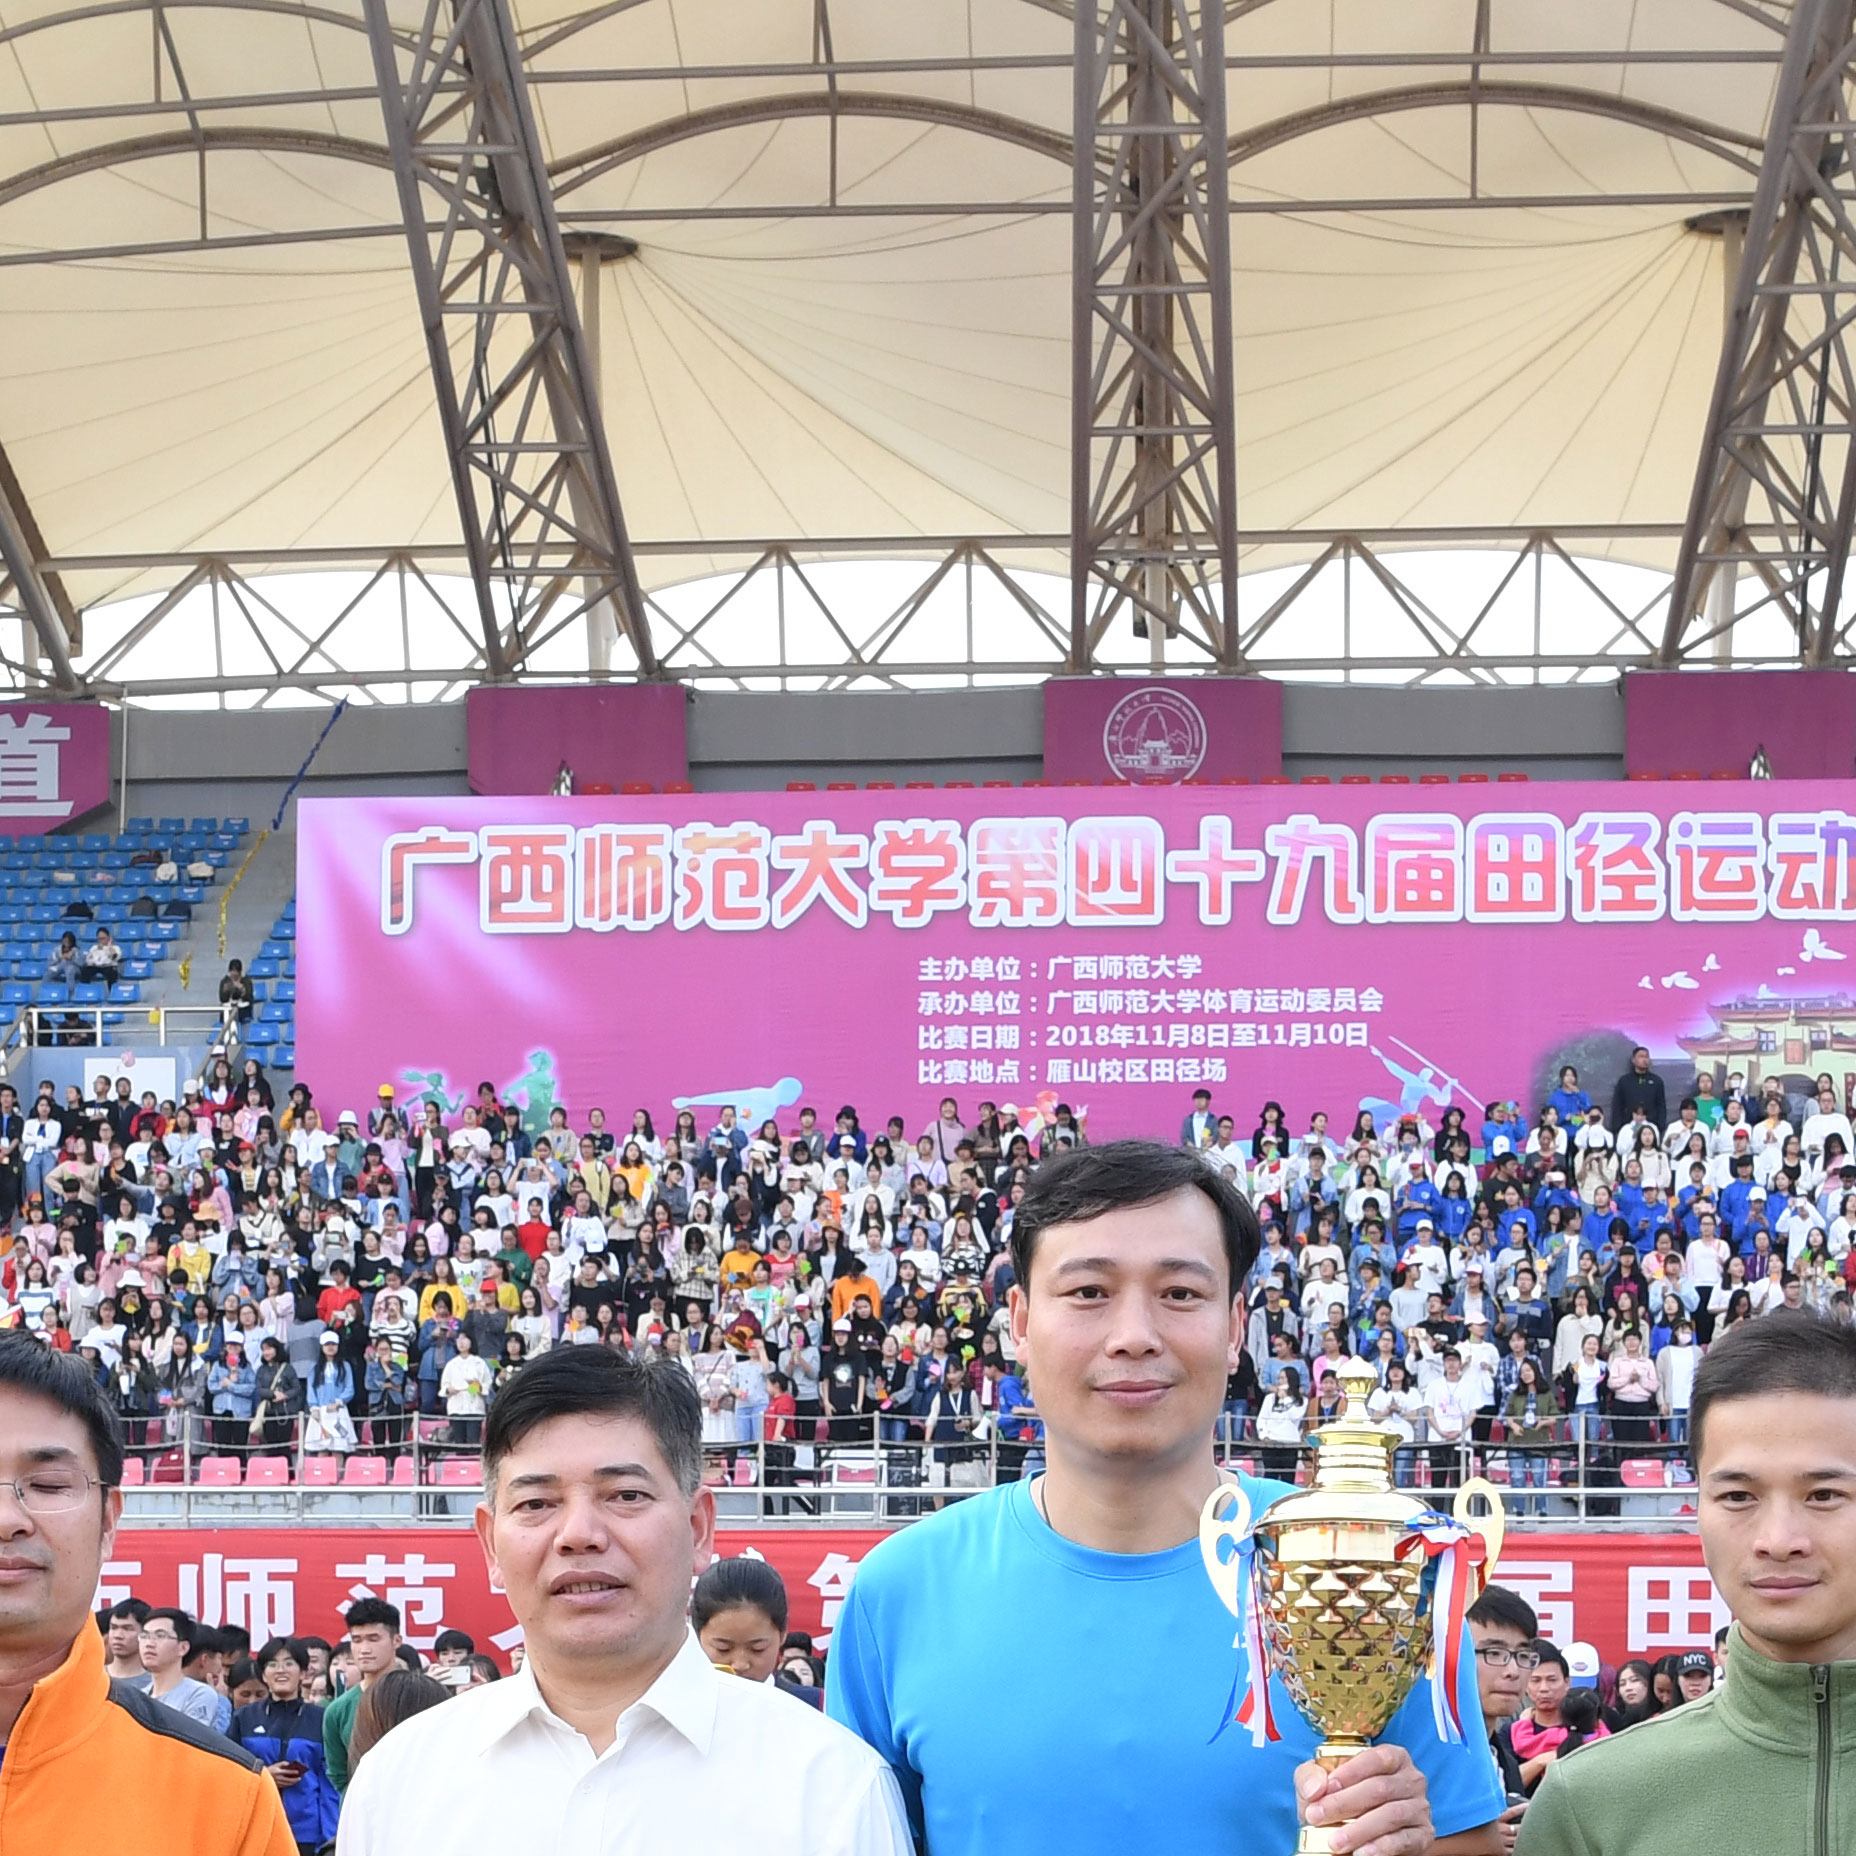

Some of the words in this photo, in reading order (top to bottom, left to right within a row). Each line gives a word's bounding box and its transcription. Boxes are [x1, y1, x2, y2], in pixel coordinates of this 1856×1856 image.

[917, 955, 1204, 981] 主办单位：广西师范大学
[917, 987, 1385, 1015] 承办单位：广西师范大学体育运动委员会
[917, 1023, 1370, 1049] 比赛日期：2018年11月8日至11月10日
[917, 1057, 1228, 1085] 比赛地点：雁山校区田径场
[1682, 1653, 1708, 1667] NYC
